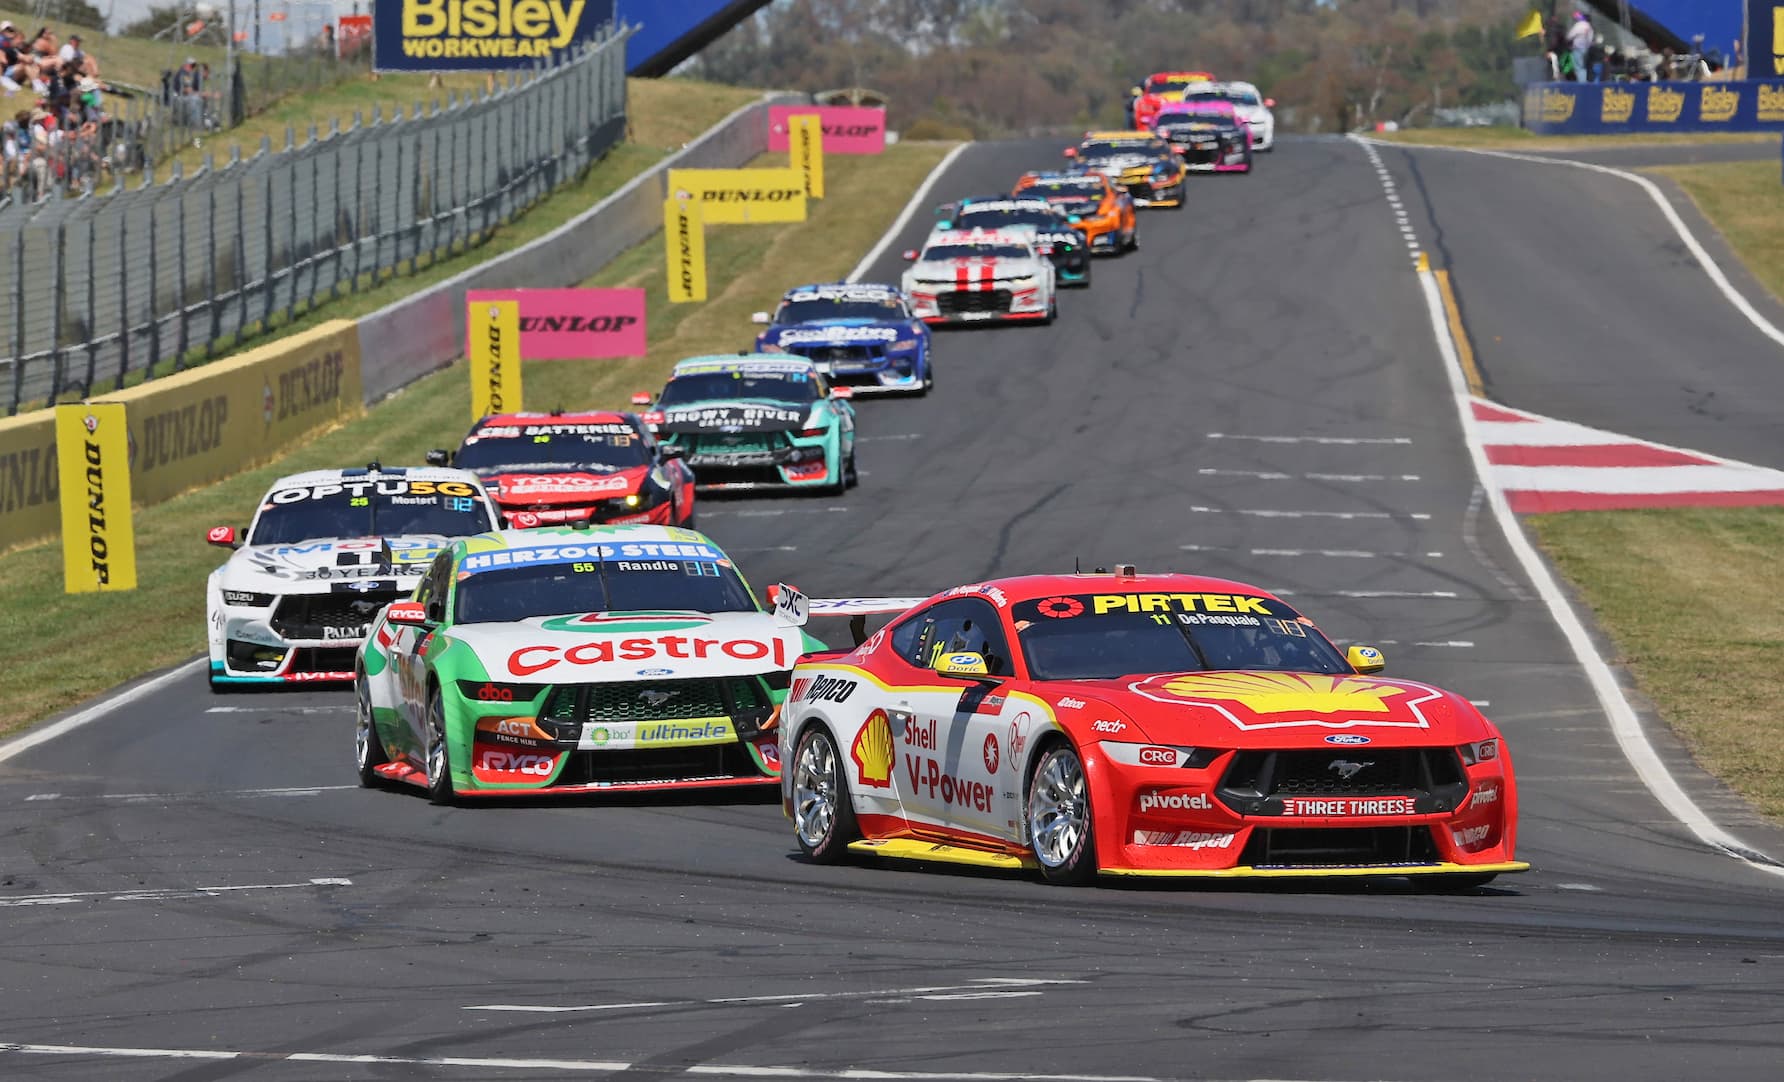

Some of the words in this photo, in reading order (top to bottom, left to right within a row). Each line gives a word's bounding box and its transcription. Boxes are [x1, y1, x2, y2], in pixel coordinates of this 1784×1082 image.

[402, 0, 586, 47] Bisley
[403, 38, 552, 58] WORKWEAR
[702, 188, 802, 202] DUNLOP
[678, 214, 693, 298] DUNLOP
[519, 315, 637, 333] UNLOP
[488, 322, 504, 416] DUNLO
[277, 349, 344, 422] DUNLOP
[665, 409, 730, 424] SNOWY
[743, 408, 801, 423] RIVER
[143, 395, 229, 472] DUNLOP
[525, 424, 634, 436] BATTERIES
[512, 476, 628, 487] TOYOTA
[350, 497, 369, 507] 25
[391, 495, 438, 506] Mostert
[85, 439, 109, 585] DUNLOP
[466, 545, 613, 569] HERZOG
[620, 544, 718, 558] STEEL
[573, 562, 595, 573] 55
[617, 561, 679, 572] Randle
[224, 592, 254, 601] ISUZU
[1093, 594, 1273, 615] PIRTEK
[389, 610, 426, 619] RYCO
[1150, 613, 1172, 625] 11
[322, 625, 360, 641] PALM
[947, 664, 979, 672] Doric
[478, 683, 513, 701] dba
[497, 720, 531, 736] ACT
[612, 730, 629, 741] bp
[641, 722, 726, 741] ultimate
[904, 715, 937, 751] Shell
[496, 734, 519, 744] FENCE
[482, 751, 554, 776] RYCO
[1141, 750, 1174, 763] CRC
[905, 753, 994, 813] V-Power
[1296, 801, 1346, 815] THREE
[1349, 800, 1405, 815] THREES
